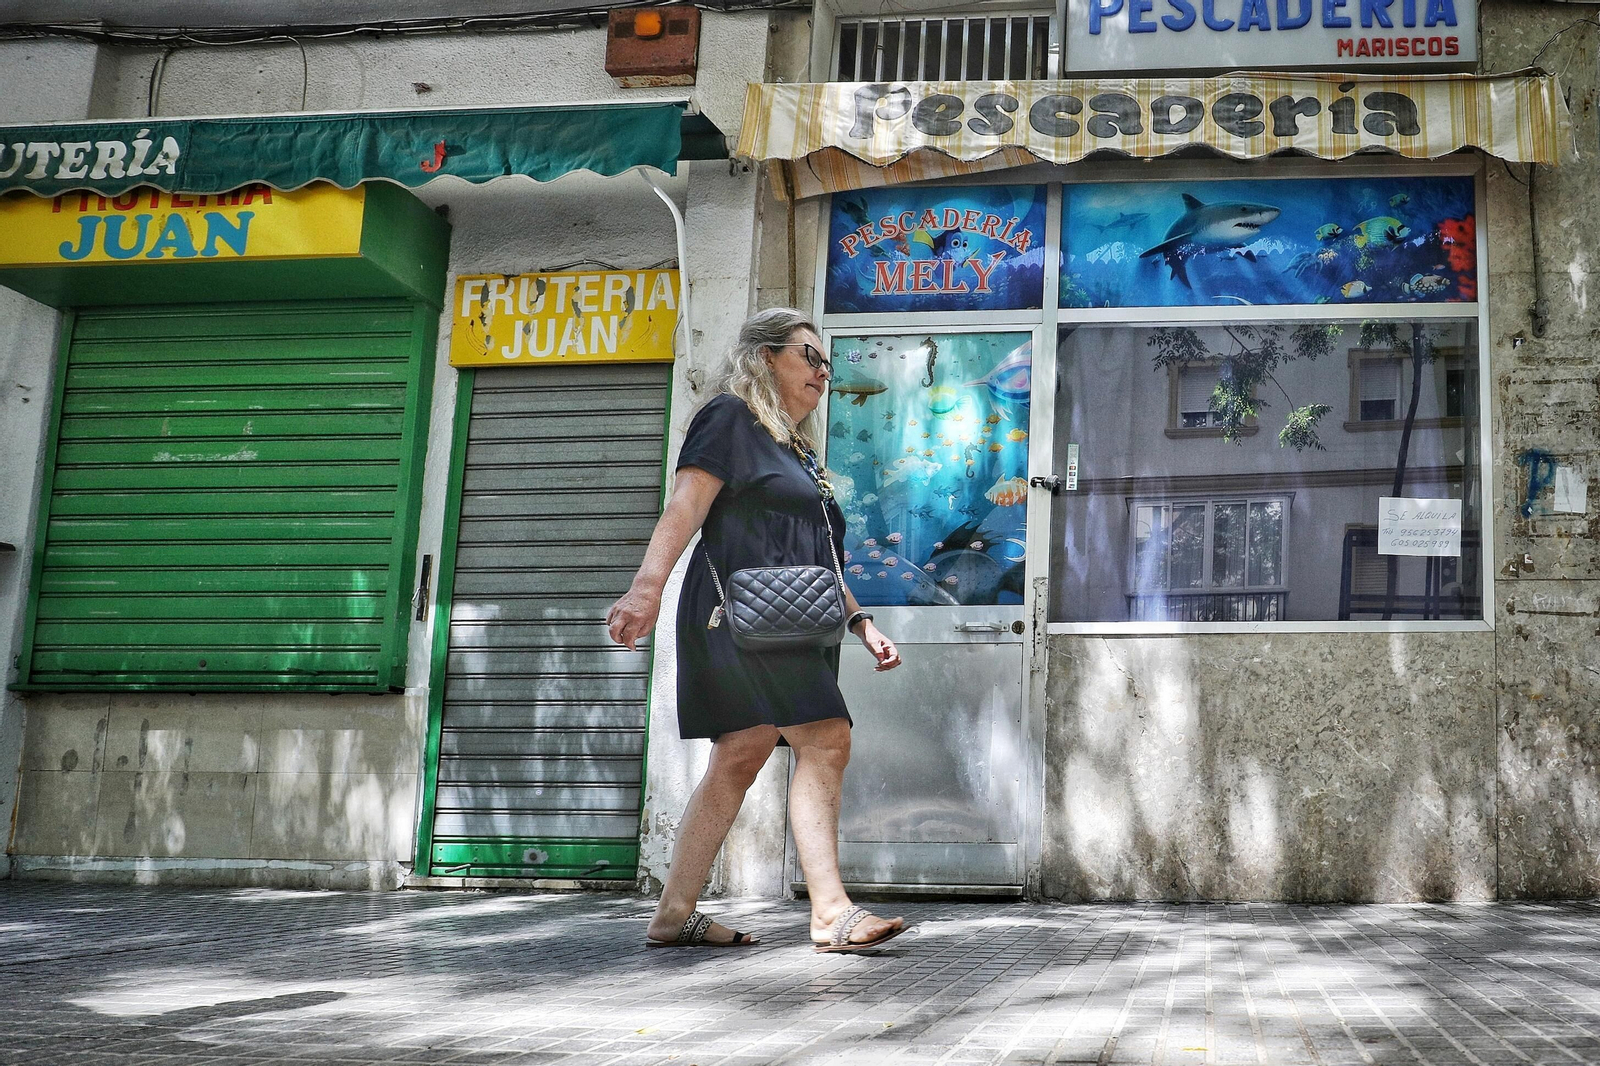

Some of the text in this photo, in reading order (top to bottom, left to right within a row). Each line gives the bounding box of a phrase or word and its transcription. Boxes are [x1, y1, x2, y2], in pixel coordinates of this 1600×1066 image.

[1088, 0, 1458, 35] PESCADERIA
[1337, 36, 1459, 57] MARISCOS
[58, 210, 256, 260] JUAN
[838, 207, 1032, 259] PESCADERÍA
[461, 272, 676, 317] FRUTERIA
[870, 250, 1007, 295] MELY
[501, 315, 619, 360] JUAN
[1383, 508, 1408, 522] SE
